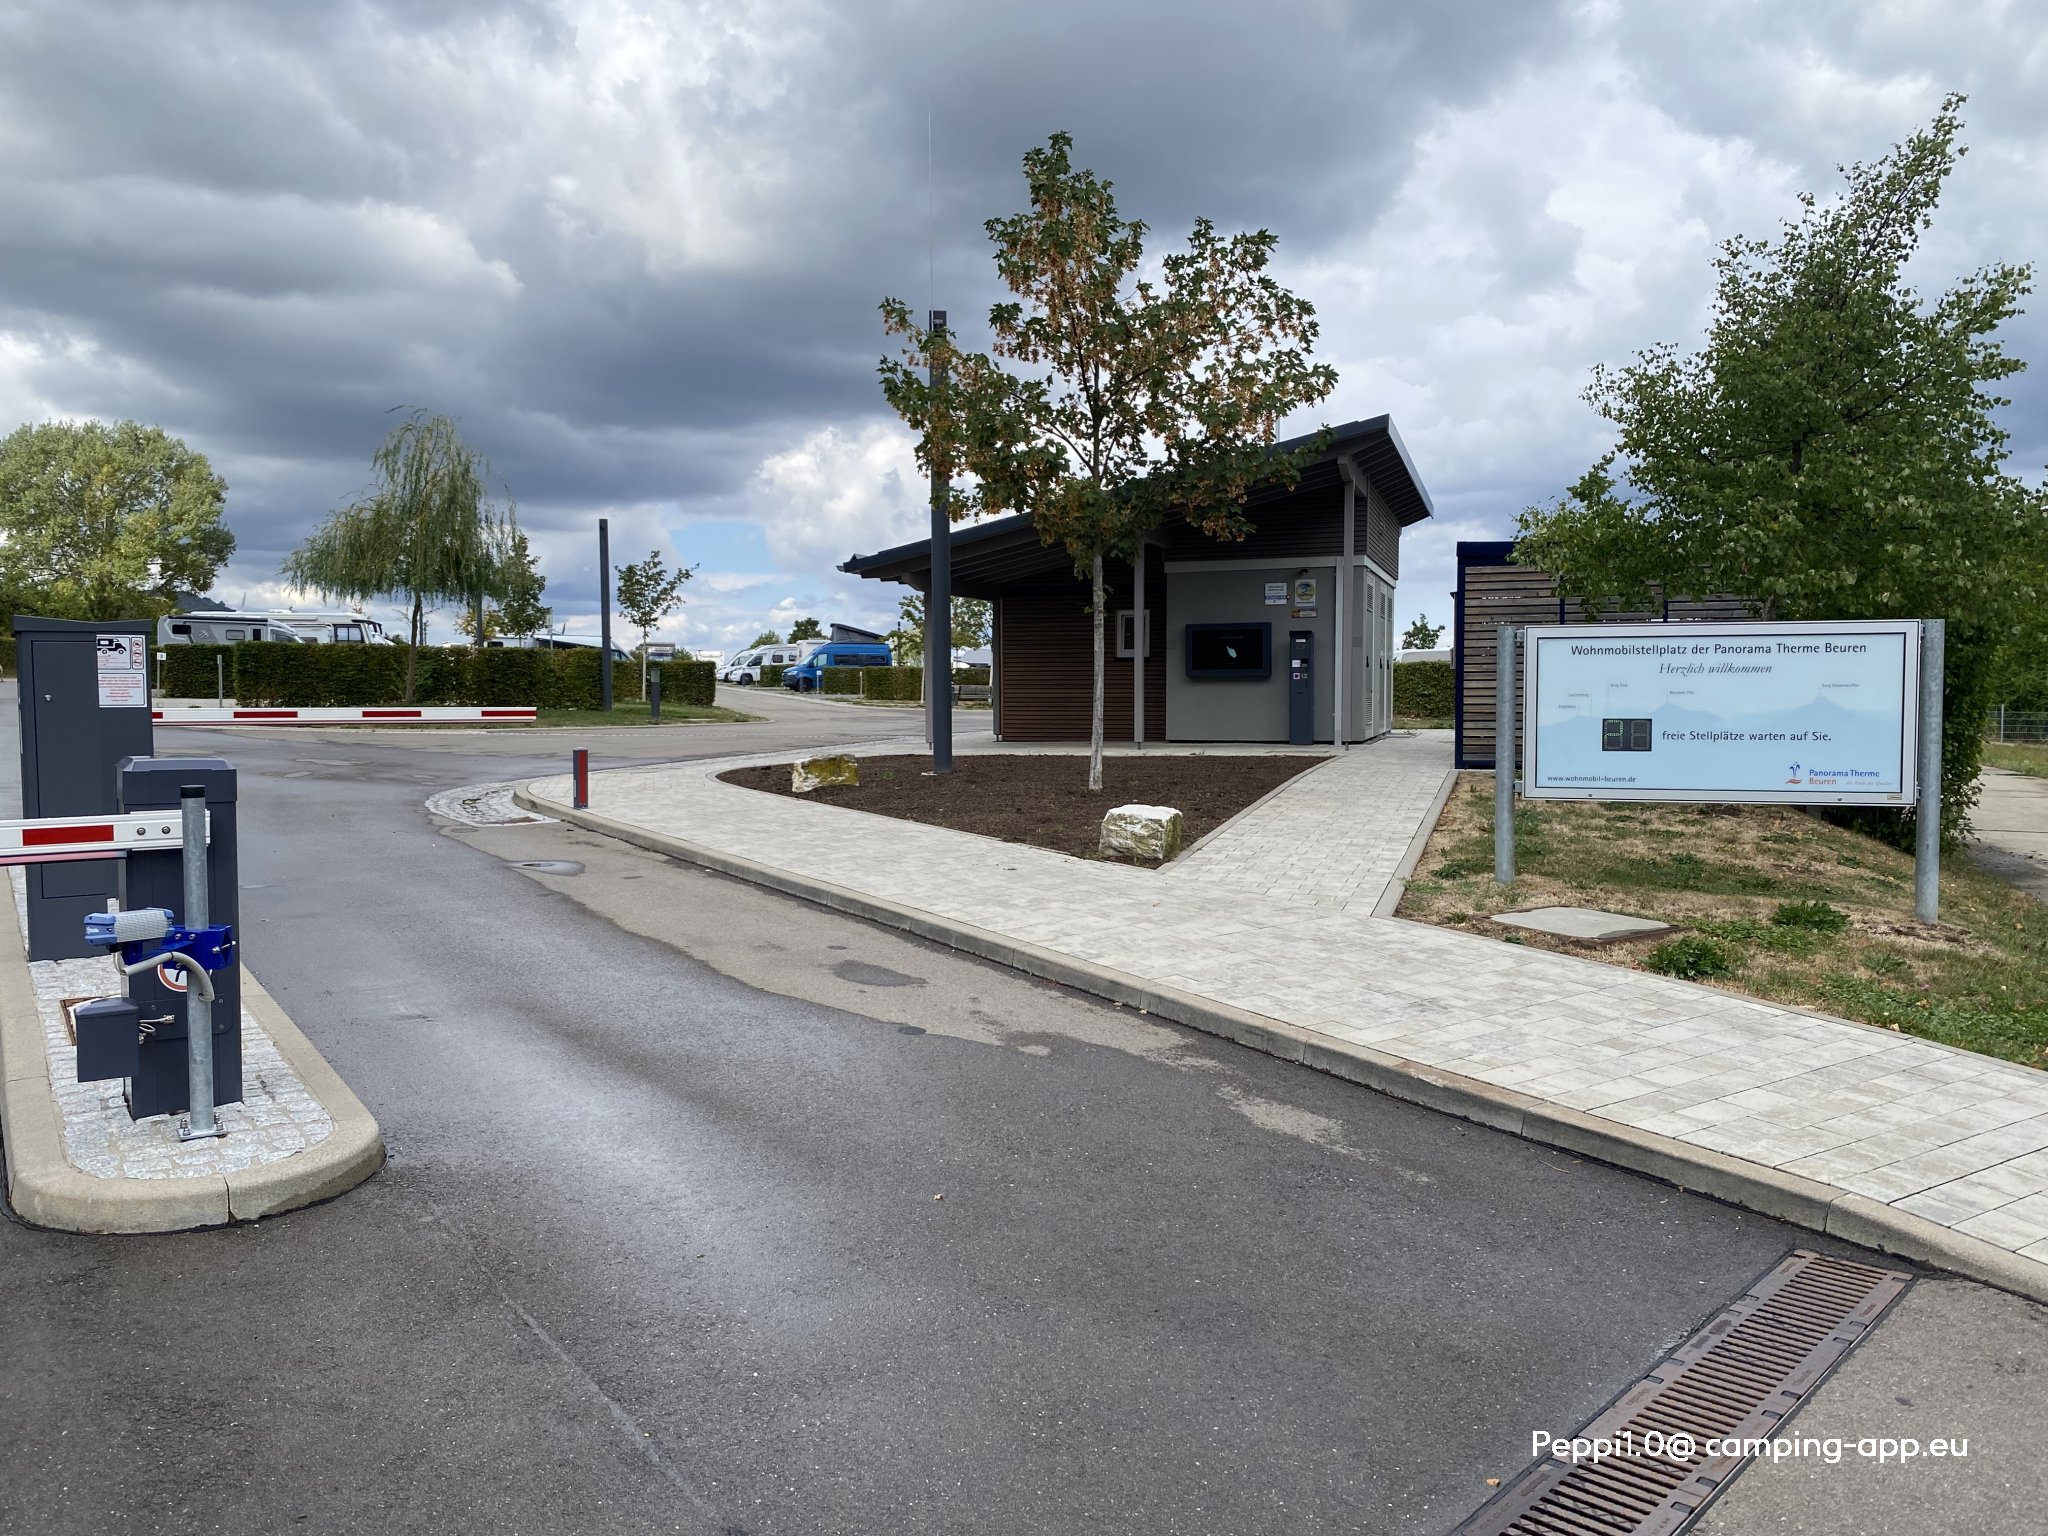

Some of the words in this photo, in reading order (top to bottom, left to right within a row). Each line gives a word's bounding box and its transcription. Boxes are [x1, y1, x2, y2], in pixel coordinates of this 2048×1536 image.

[1571, 644, 1687, 657] Wohnmobilstellplatz
[1691, 644, 1710, 655] der
[1714, 644, 1772, 654] Panorama
[1776, 643, 1820, 653] Therme
[1825, 643, 1867, 653] Beuren
[1659, 663, 1705, 677] Herzlich
[1708, 663, 1773, 674] willkommen
[1662, 731, 1686, 741] freie
[1689, 731, 1745, 742] Stellplätze
[1749, 731, 1786, 741] warten
[1790, 731, 1809, 741] auf
[1812, 732, 1832, 741] Sie.
[1809, 769, 1848, 777] Panorama
